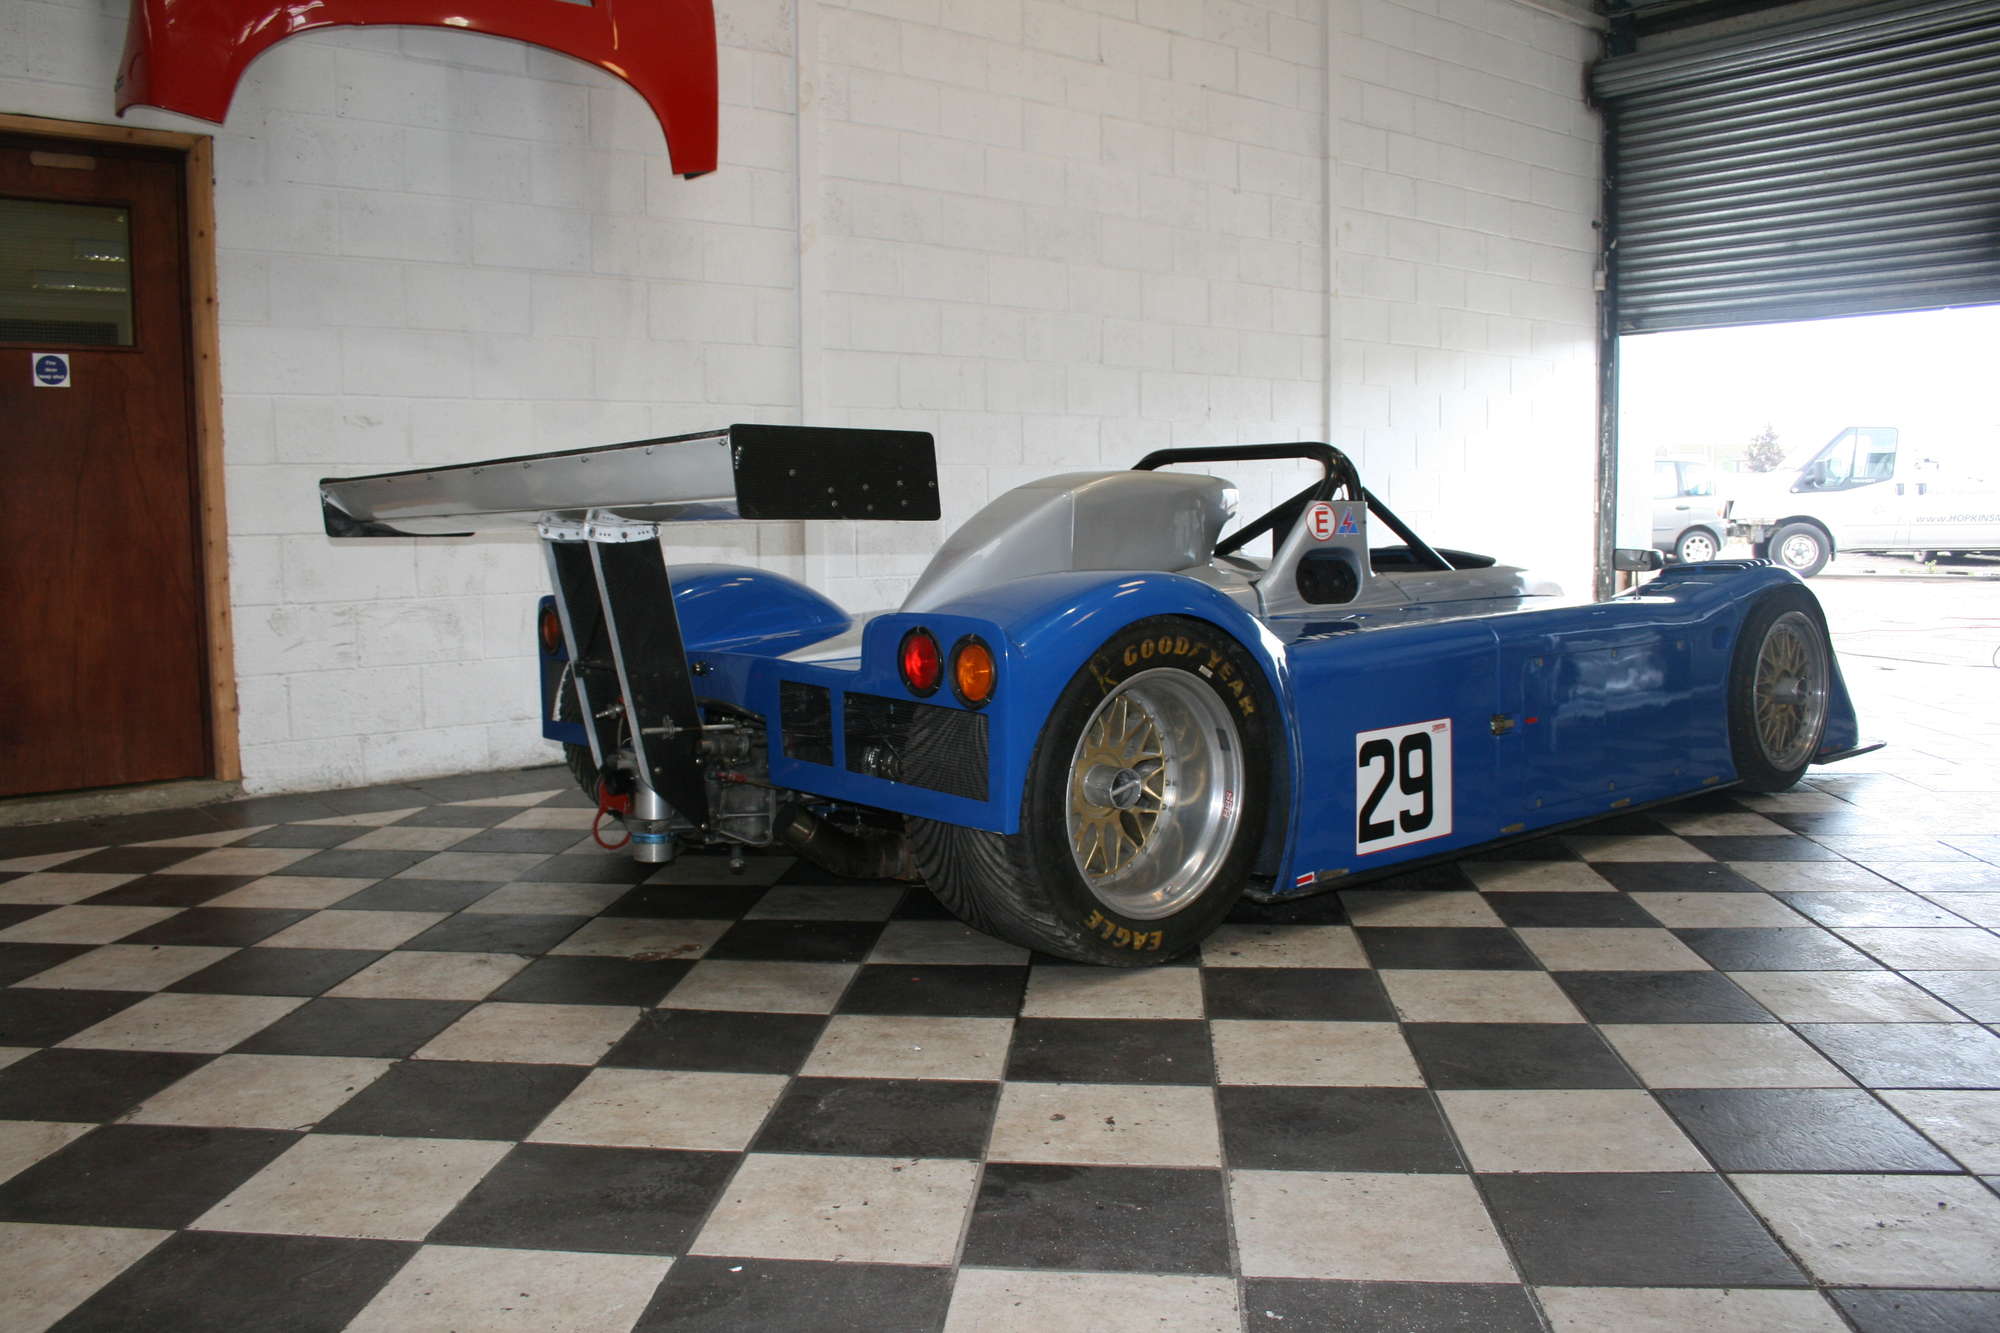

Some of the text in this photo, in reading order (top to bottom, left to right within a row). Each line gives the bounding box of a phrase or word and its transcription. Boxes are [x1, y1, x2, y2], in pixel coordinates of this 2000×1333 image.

[1315, 510, 1329, 533] E
[1124, 635, 1255, 717] GOODYEAR
[1359, 731, 1433, 844] 29
[1086, 909, 1164, 952] EAGLE
